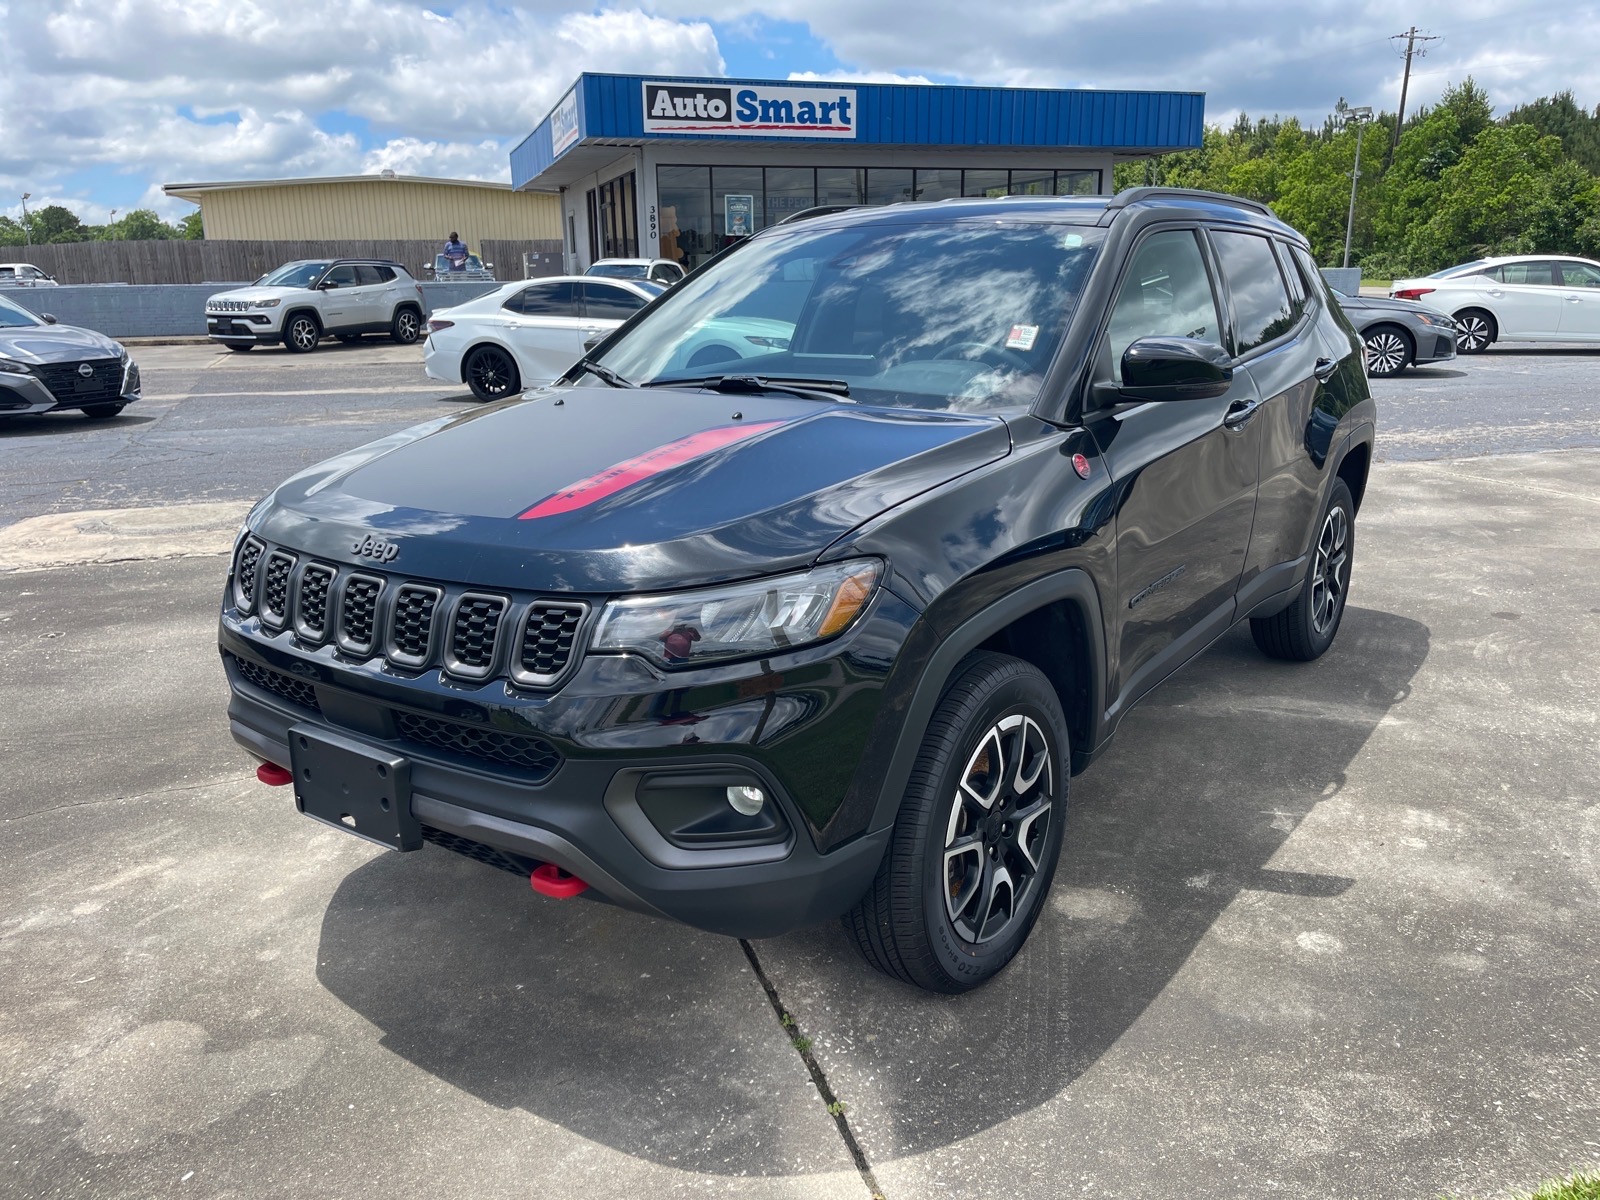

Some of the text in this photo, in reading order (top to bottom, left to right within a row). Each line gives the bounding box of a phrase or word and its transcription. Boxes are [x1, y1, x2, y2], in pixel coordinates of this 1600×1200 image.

[651, 90, 851, 125] Auto Smart
[766, 197, 785, 208] THE
[649, 205, 657, 239] 3890
[350, 533, 400, 564] Jeep
